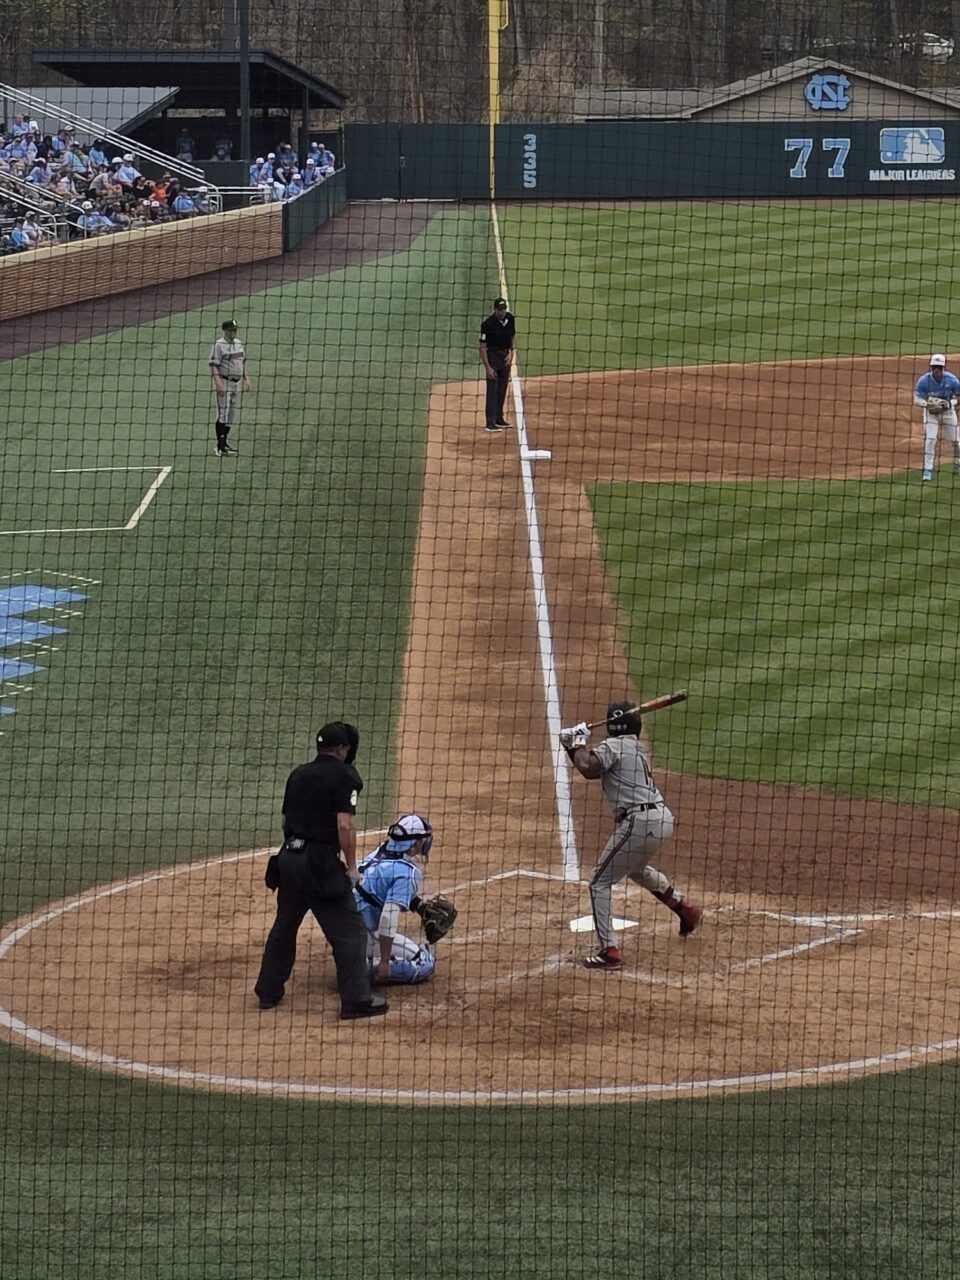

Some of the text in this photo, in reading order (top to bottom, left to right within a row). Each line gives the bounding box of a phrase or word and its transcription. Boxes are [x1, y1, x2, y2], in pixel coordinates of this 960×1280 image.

[523, 133, 537, 188] 335
[784, 138, 851, 178] 77
[869, 169, 956, 181] MAJOR LEAGUERS
